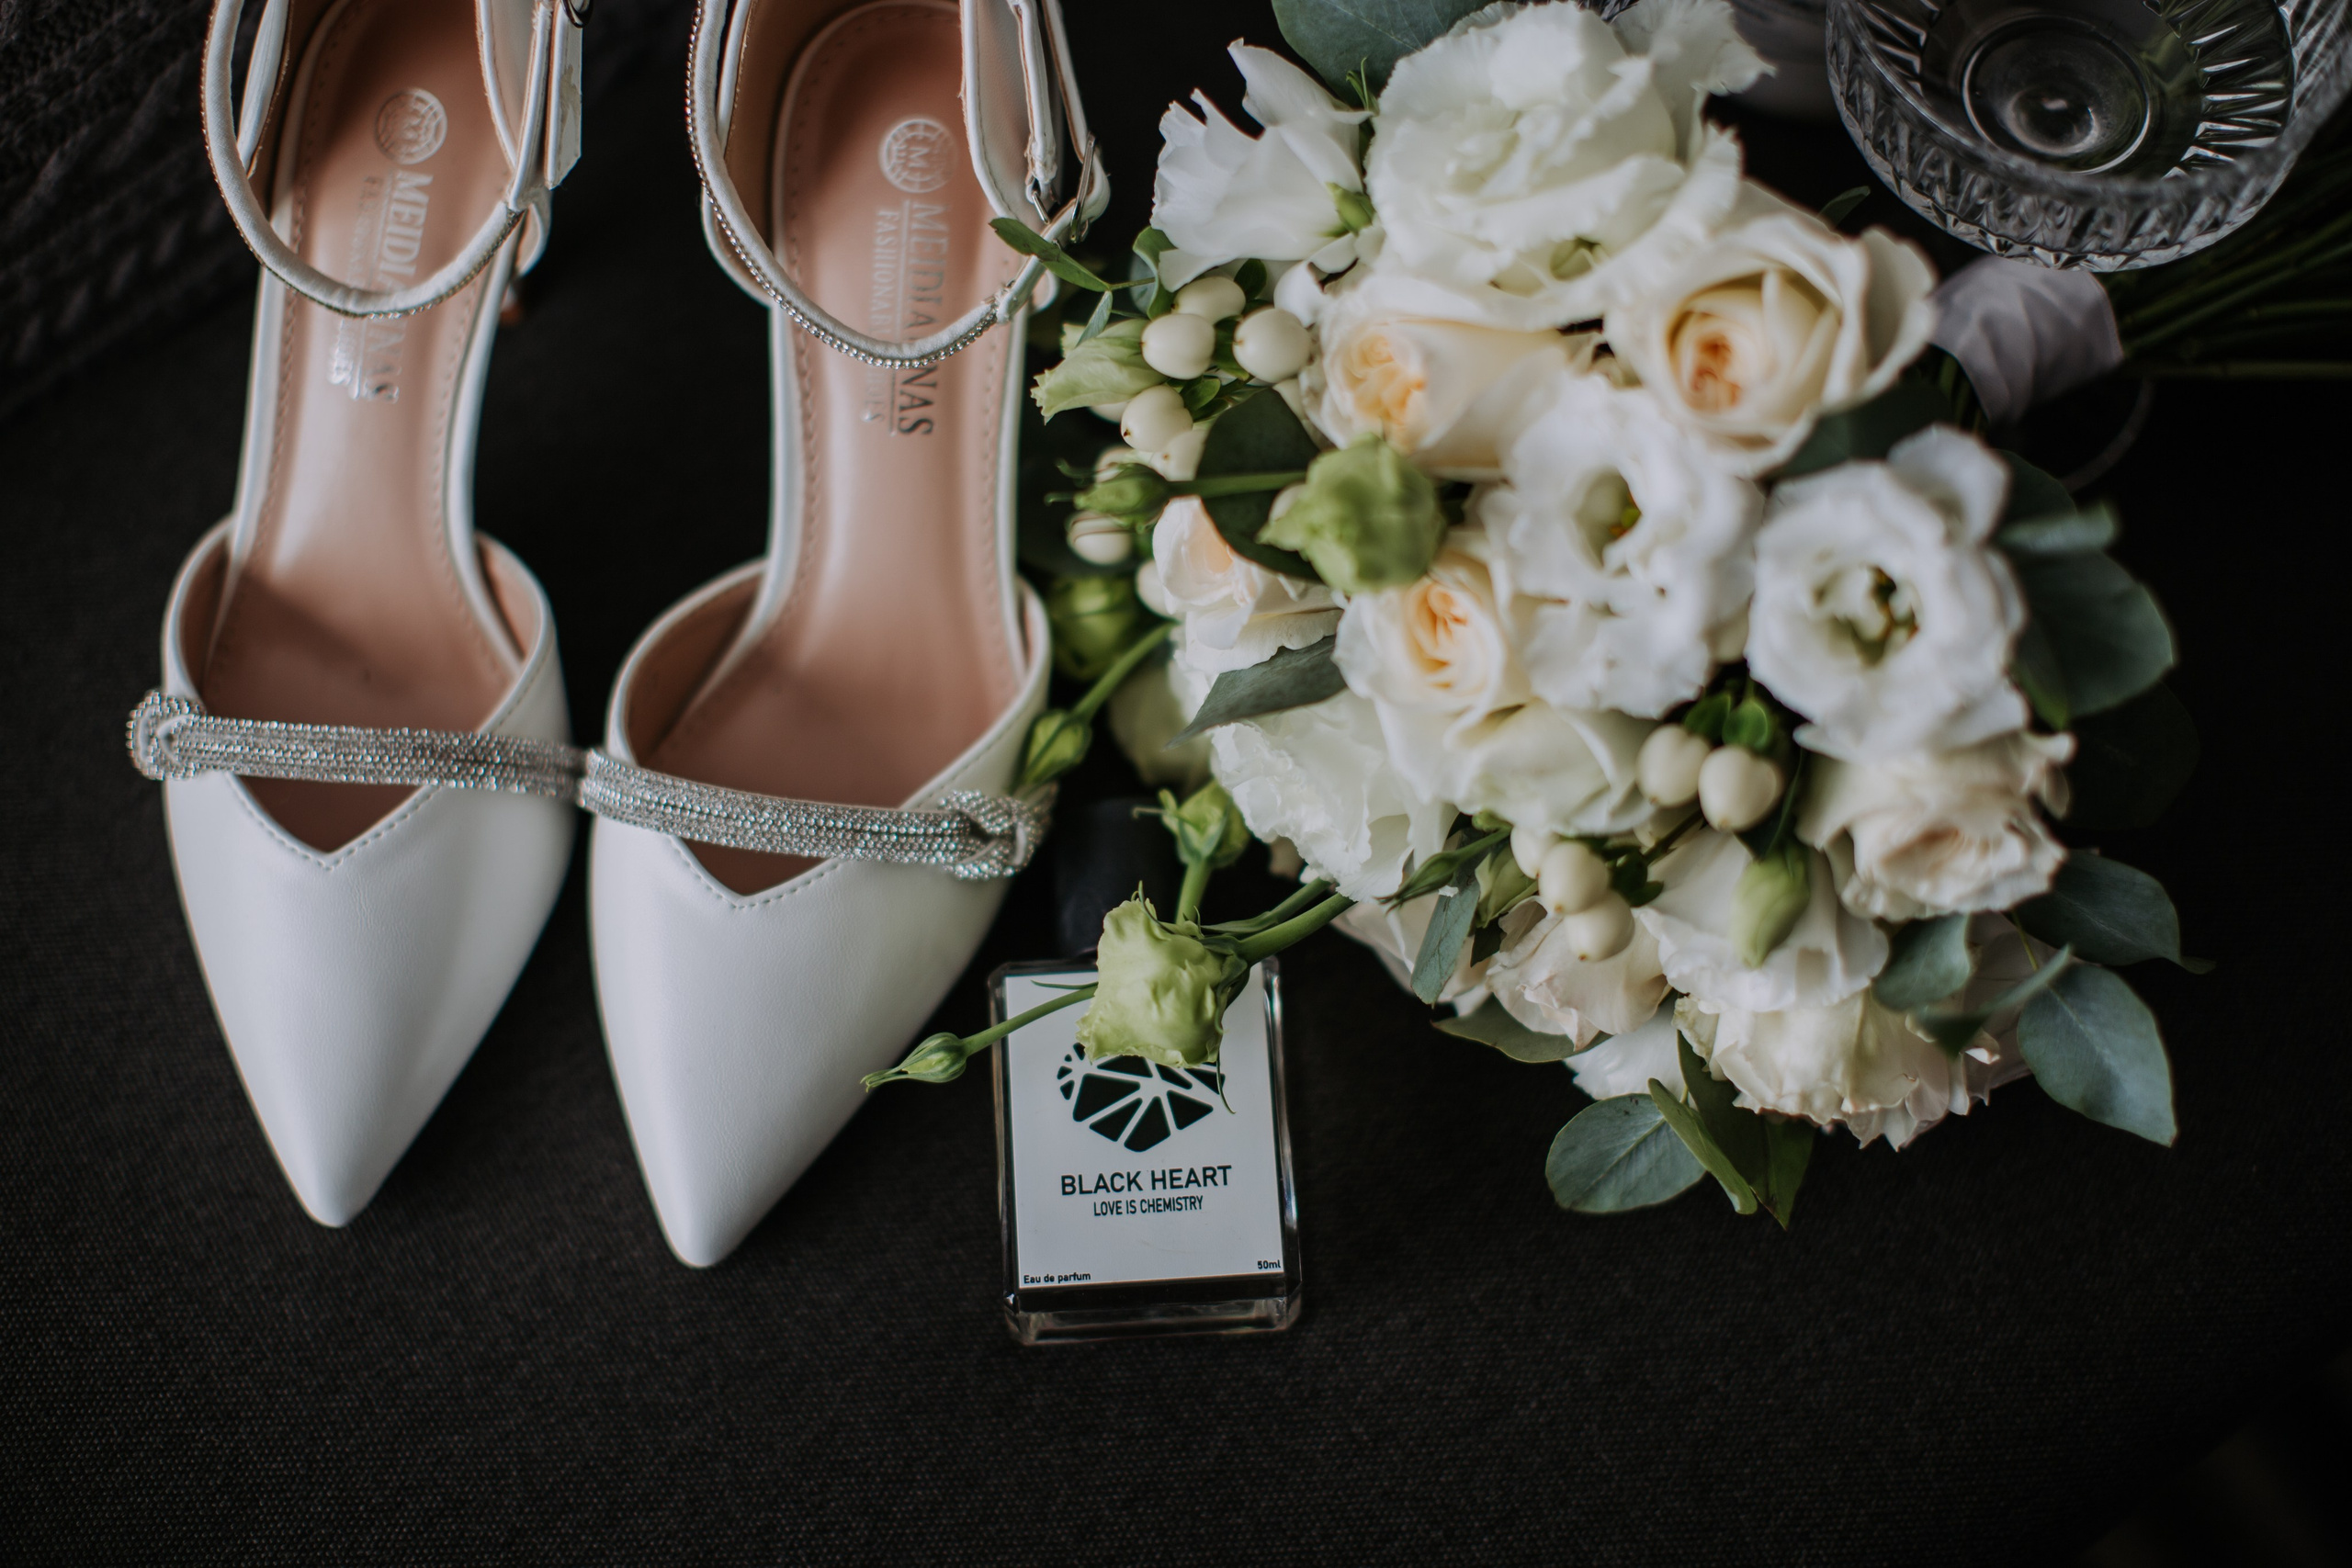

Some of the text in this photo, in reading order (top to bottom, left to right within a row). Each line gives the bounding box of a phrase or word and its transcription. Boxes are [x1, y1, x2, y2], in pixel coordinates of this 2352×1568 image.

[363, 170, 434, 404] MEIDIANAS
[870, 209, 901, 336] FASHIONABL
[898, 201, 951, 435] MEIDIANAS
[1060, 1165, 1232, 1196] BLACK HEART
[1093, 1195, 1204, 1216] LOVE IS CHEMISTRY
[1023, 1271, 1091, 1284] Eau de parfum
[1257, 1259, 1282, 1269] 50ml
